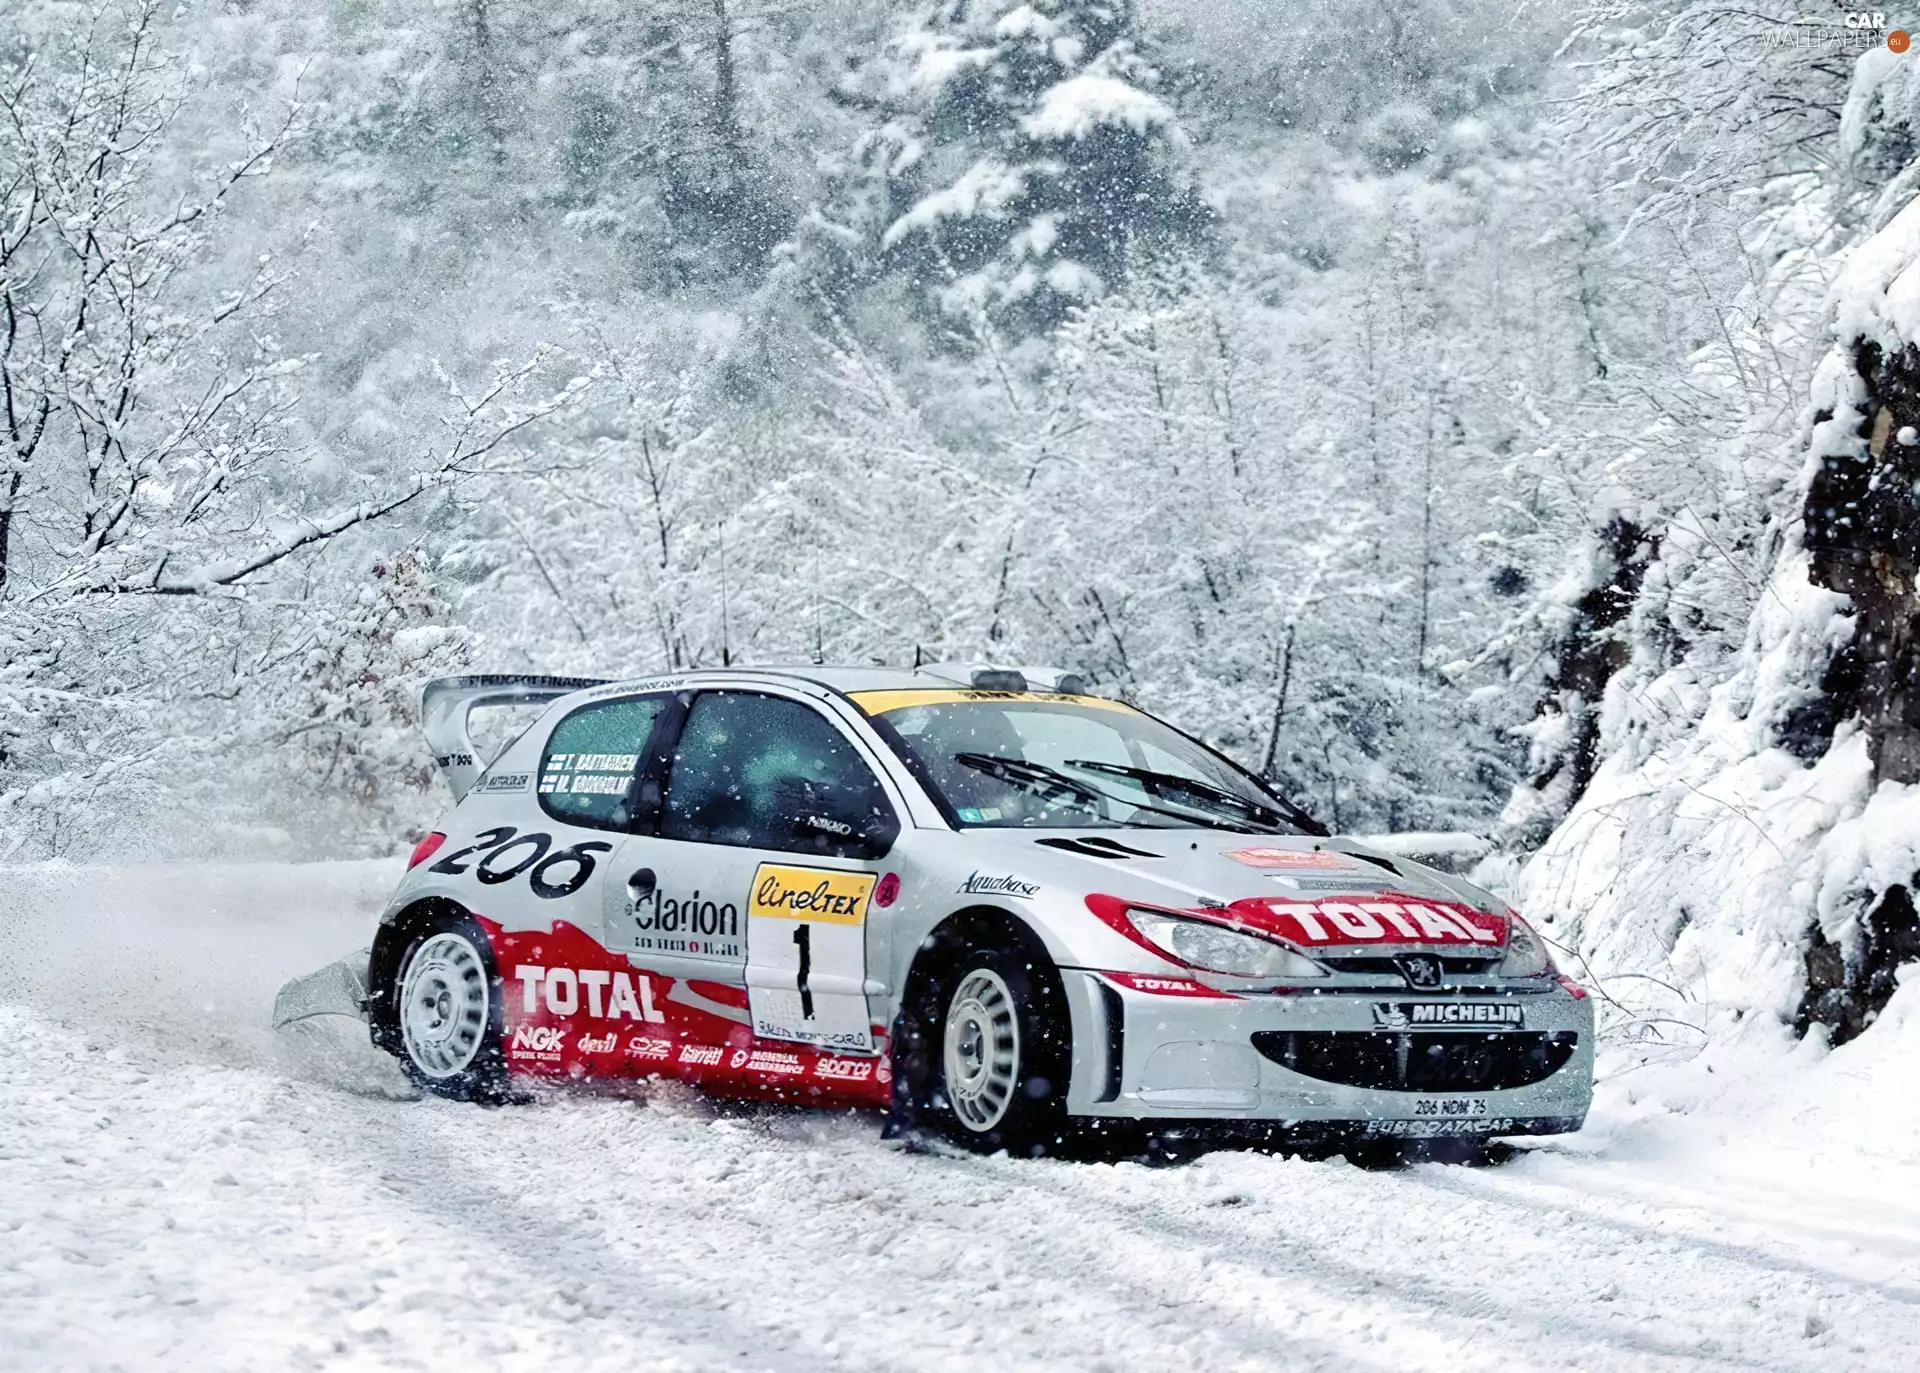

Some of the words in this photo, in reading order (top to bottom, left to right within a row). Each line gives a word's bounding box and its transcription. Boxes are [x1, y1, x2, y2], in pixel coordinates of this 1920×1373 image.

[428, 826, 613, 899] 206
[956, 870, 1041, 896] Aquabase
[635, 889, 737, 936] Clarion
[1269, 903, 1498, 941] TOTAL
[793, 924, 816, 1020] 1
[1131, 978, 1197, 991] TOTAL
[515, 964, 665, 1023] TOTAL
[1412, 1005, 1521, 1021] MICHELIN
[511, 1025, 566, 1051] NGK
[577, 1032, 617, 1055] devil
[629, 1036, 672, 1053] OZ
[815, 1057, 872, 1077] sparco
[1415, 1099, 1438, 1115] 206
